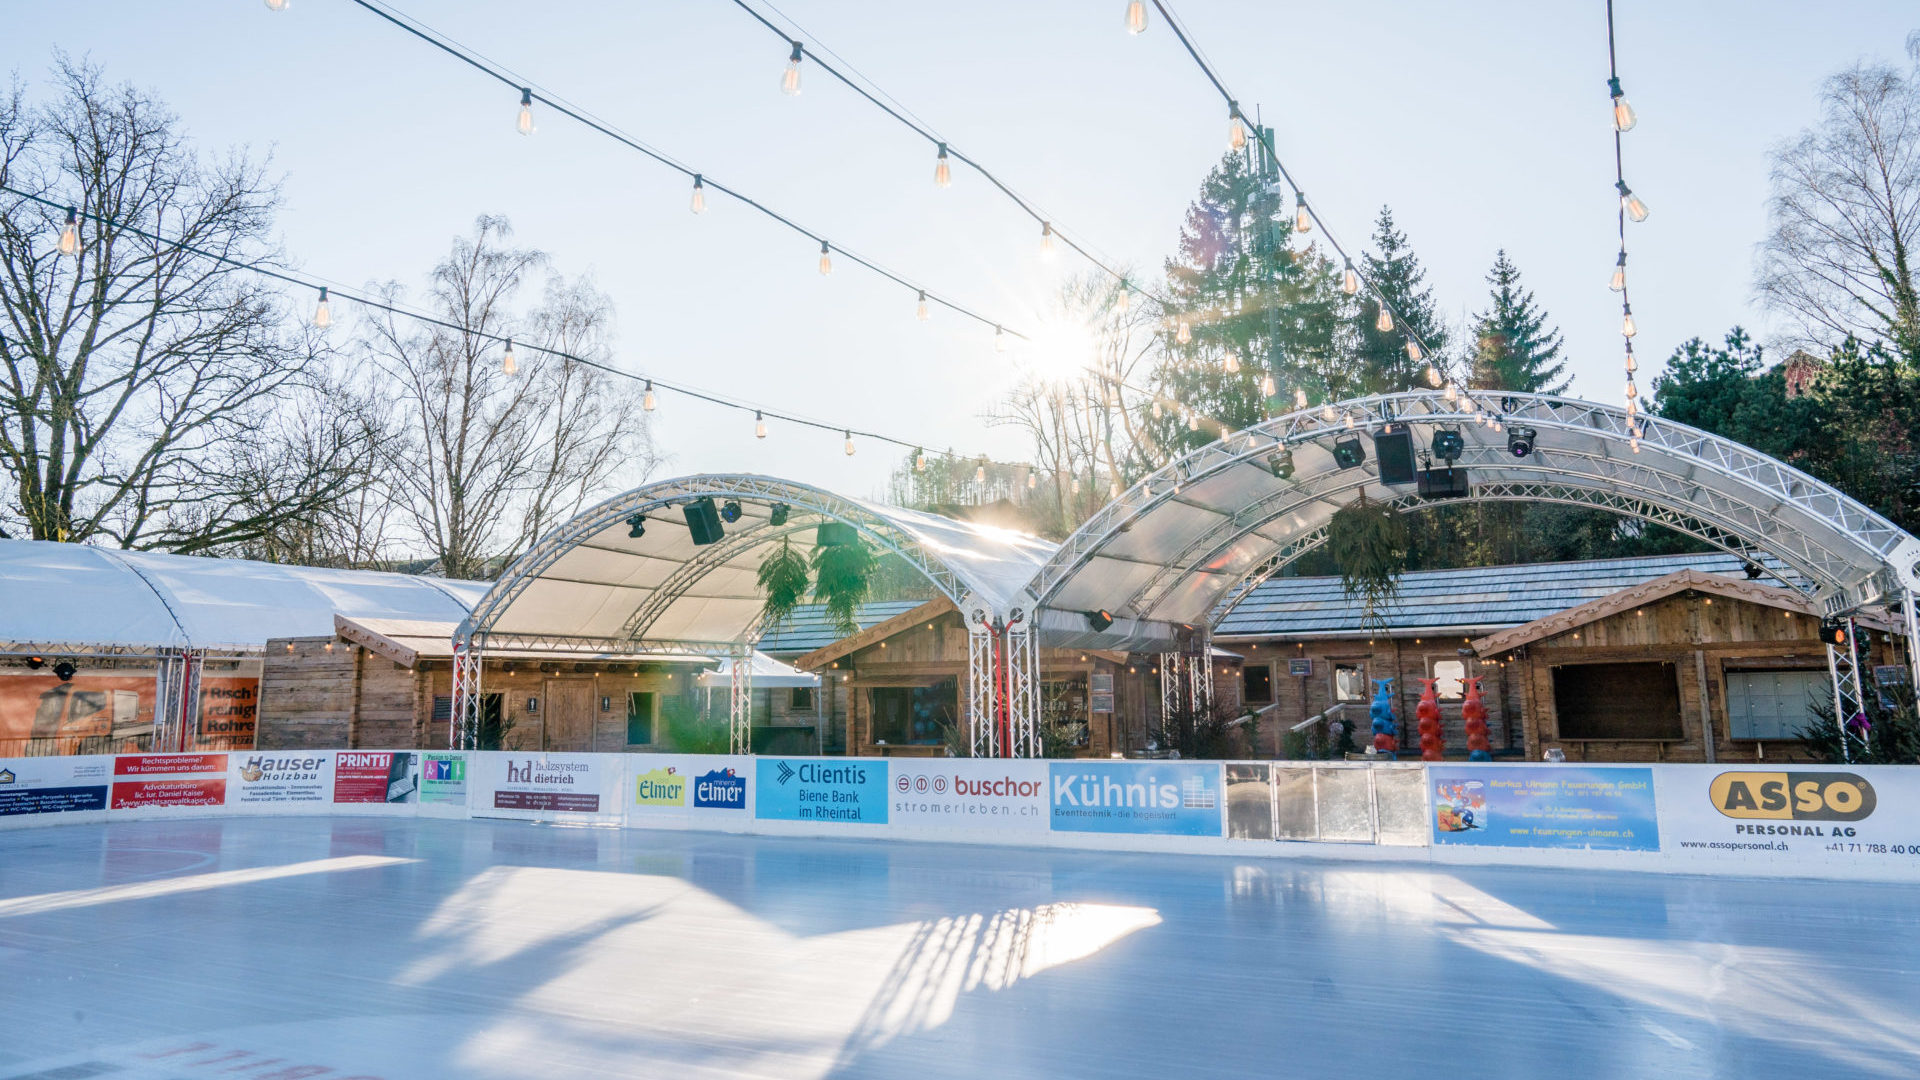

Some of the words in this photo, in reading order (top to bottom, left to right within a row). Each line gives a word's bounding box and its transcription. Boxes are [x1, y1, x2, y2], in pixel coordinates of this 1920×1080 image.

[210, 687, 251, 699] Risch
[207, 719, 255, 731] Rohre
[142, 756, 203, 766] Rechtsprobleme?
[246, 755, 326, 771] Hauser
[262, 772, 317, 781] Holzbau
[506, 760, 532, 783] hd
[534, 773, 574, 784] dietrich
[799, 764, 866, 784] Clientis
[143, 783, 197, 791] Advokaturbüro
[640, 780, 682, 799] Elmer
[698, 781, 742, 802] Elmer
[955, 775, 1042, 797] buschor
[1054, 774, 1180, 809] Kühnis
[1618, 781, 1647, 790] GmbH
[799, 789, 829, 802] Biene
[832, 790, 859, 803] Bank
[1724, 780, 1863, 813] ASSO
[799, 805, 812, 817] im
[815, 805, 861, 819] Rheintal
[895, 802, 1039, 816] stromerleben.ch
[1117, 810, 1131, 818] die
[1735, 824, 1824, 837] PERSONAL
[1831, 826, 1857, 837] AG
[1680, 840, 1789, 851] www.assopersonal.ch
[1824, 843, 1844, 852] +41
[1849, 843, 1861, 852] 71
[1866, 843, 1887, 854] 788
[1890, 844, 1905, 855] 40
